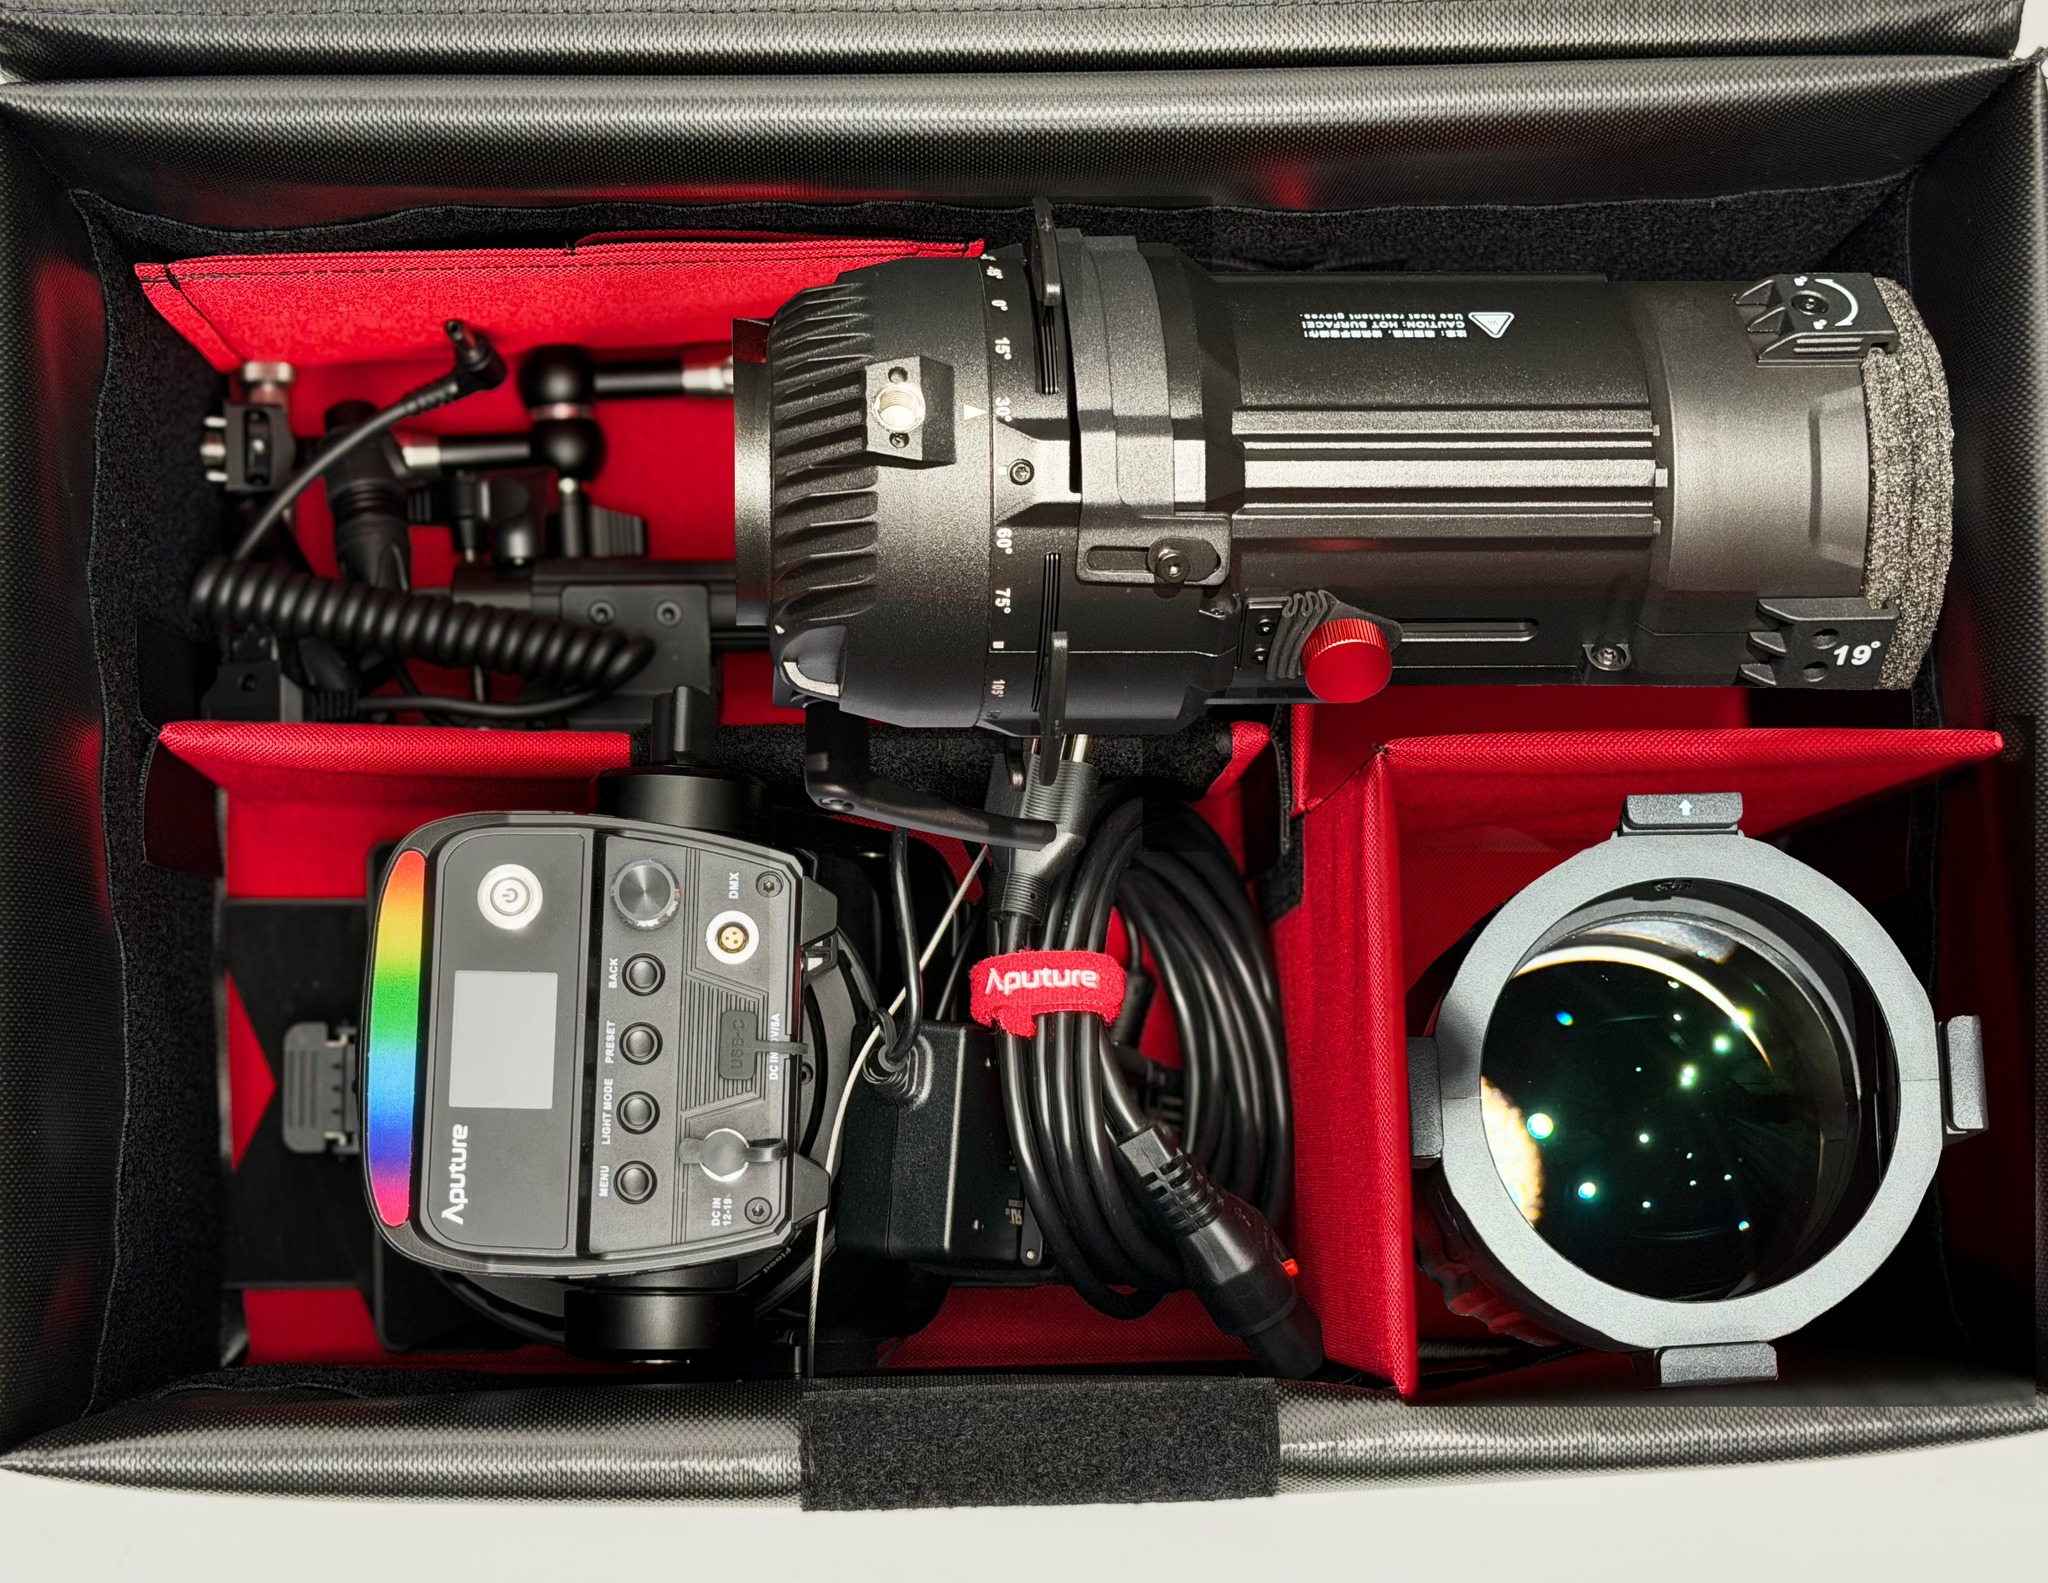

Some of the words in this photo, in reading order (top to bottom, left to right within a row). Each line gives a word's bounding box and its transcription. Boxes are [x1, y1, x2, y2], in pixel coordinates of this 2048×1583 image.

[1299, 312, 1345, 320] gloves.
[1301, 321, 1367, 329] SURFACE!
[1371, 321, 1399, 329] HOT
[1402, 321, 1465, 329] CAUTION:
[994, 337, 1012, 360] 15°
[995, 396, 1012, 422] 30°
[996, 527, 1013, 555] 60°
[994, 588, 1012, 614] 75°
[1833, 640, 1881, 666] 19°
[728, 871, 740, 899] DMX
[608, 957, 619, 989] BACK
[984, 967, 1100, 996] Aputure
[605, 1020, 616, 1064] PRESET
[730, 1020, 745, 1070] USB-C
[769, 1052, 779, 1063] IN
[768, 1065, 779, 1081] DC
[603, 1078, 614, 1106] MODE
[601, 1112, 612, 1145] LIGHT
[441, 1124, 469, 1225] Aputure
[599, 1165, 610, 1197] MENU
[712, 1197, 722, 1209] IN
[722, 1193, 733, 1227] 12-19
[711, 1210, 721, 1227] DC
